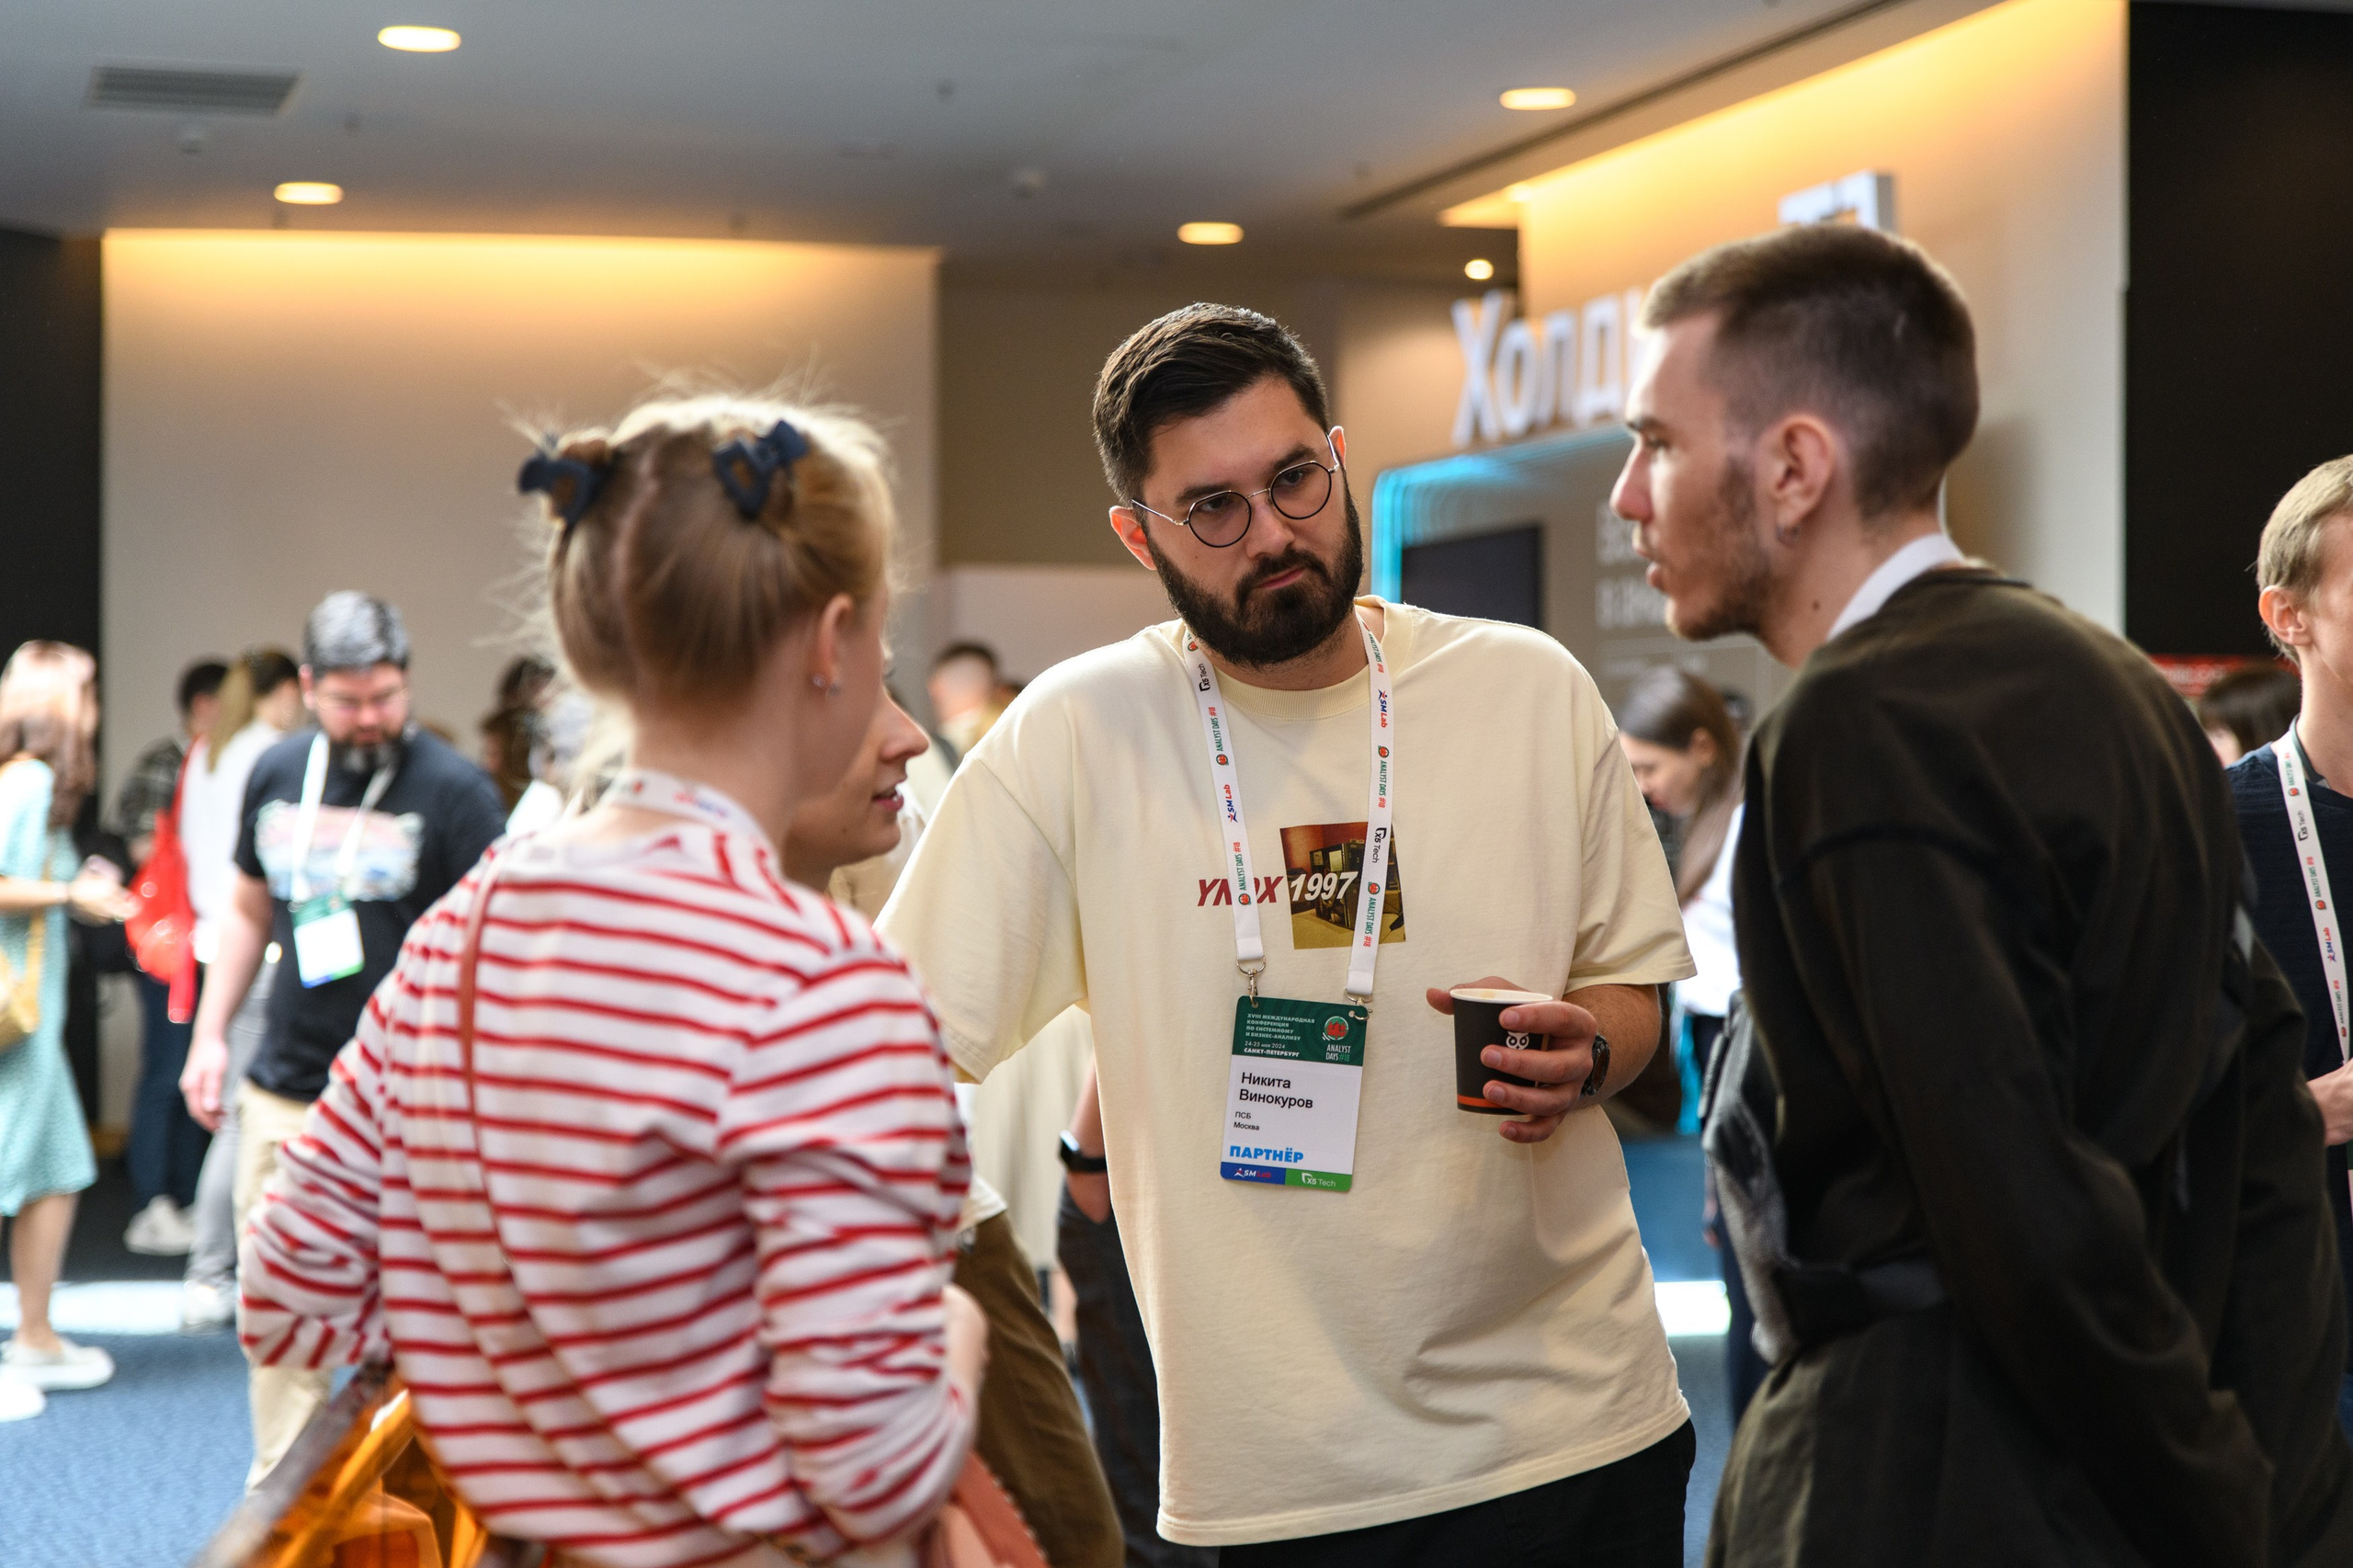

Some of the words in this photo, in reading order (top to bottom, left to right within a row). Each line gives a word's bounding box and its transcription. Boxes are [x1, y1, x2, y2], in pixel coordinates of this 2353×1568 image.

[1199, 663, 1208, 677] Tech
[1381, 699, 1387, 712] SM
[1211, 717, 1220, 730] DAYS
[1214, 730, 1223, 752] ANALYST
[1227, 800, 1234, 812] SM
[1235, 853, 1244, 866] DAYS
[1372, 845, 1381, 863] Tech
[1237, 868, 1246, 891] ANALYST
[1198, 876, 1284, 906] YNX
[1290, 871, 1358, 902] 1997
[1367, 897, 1376, 921] ANALYST
[1365, 921, 1374, 935] DAYS
[1363, 936, 1372, 948] #18
[1262, 1015, 1315, 1024] МЕЖДУНАРОДНАЯ
[1251, 1032, 1301, 1040] БИЗНЕС-АНАЛИЗУ
[1244, 1048, 1300, 1057] САНКТ-ПЕТЕРБУРГ
[1326, 1044, 1351, 1053] ANALYST
[1325, 1052, 1338, 1061] DAYS
[1339, 1053, 1350, 1062] #18
[1241, 1072, 1291, 1089] Никита
[1239, 1088, 1313, 1108] Винокуров
[1234, 1111, 1251, 1119] ПСБ
[1233, 1121, 1260, 1131] Москва
[1229, 1145, 1303, 1164] ПАРТНЁР
[1244, 1169, 1256, 1177] SM
[1317, 1178, 1336, 1187] Tech
